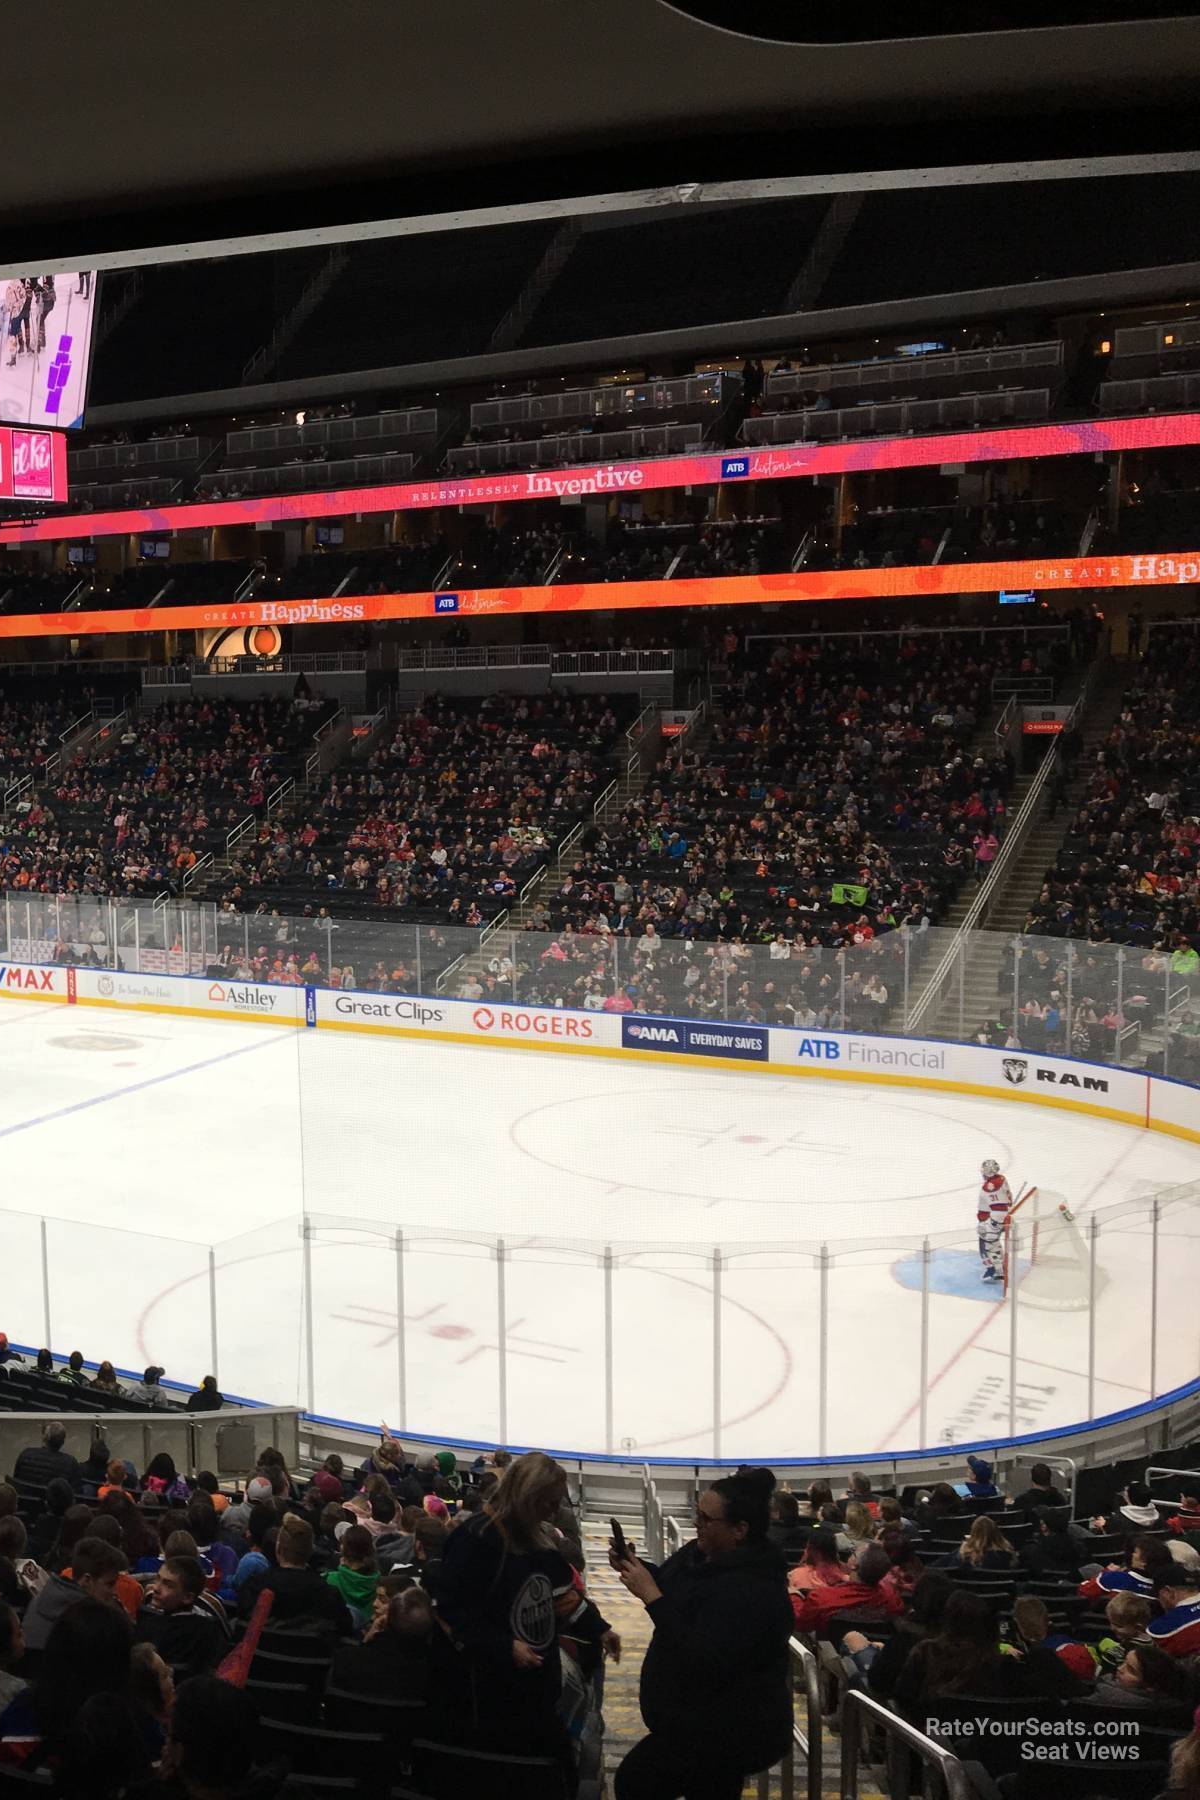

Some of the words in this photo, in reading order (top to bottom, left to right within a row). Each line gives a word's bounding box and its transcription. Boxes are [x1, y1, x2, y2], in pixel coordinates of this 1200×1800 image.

[726, 462, 745, 473] ATB
[412, 483, 520, 501] RELENTLESSLY
[526, 466, 644, 496] Inventive
[1034, 566, 1121, 580] CREATE
[204, 612, 255, 621] CREATE
[260, 599, 364, 624] Happiness
[439, 599, 455, 608] ATB
[226, 987, 277, 1010] Ashley
[335, 996, 391, 1017] Great
[395, 1001, 443, 1025] Clips
[501, 1011, 593, 1037] ROGERS
[638, 1026, 680, 1043] AMA
[689, 1032, 734, 1048] EVERYDAY
[734, 1036, 763, 1051] SAVES
[798, 1038, 840, 1060] ATB
[848, 1042, 945, 1070] Financial
[1036, 1068, 1109, 1093] RAM
